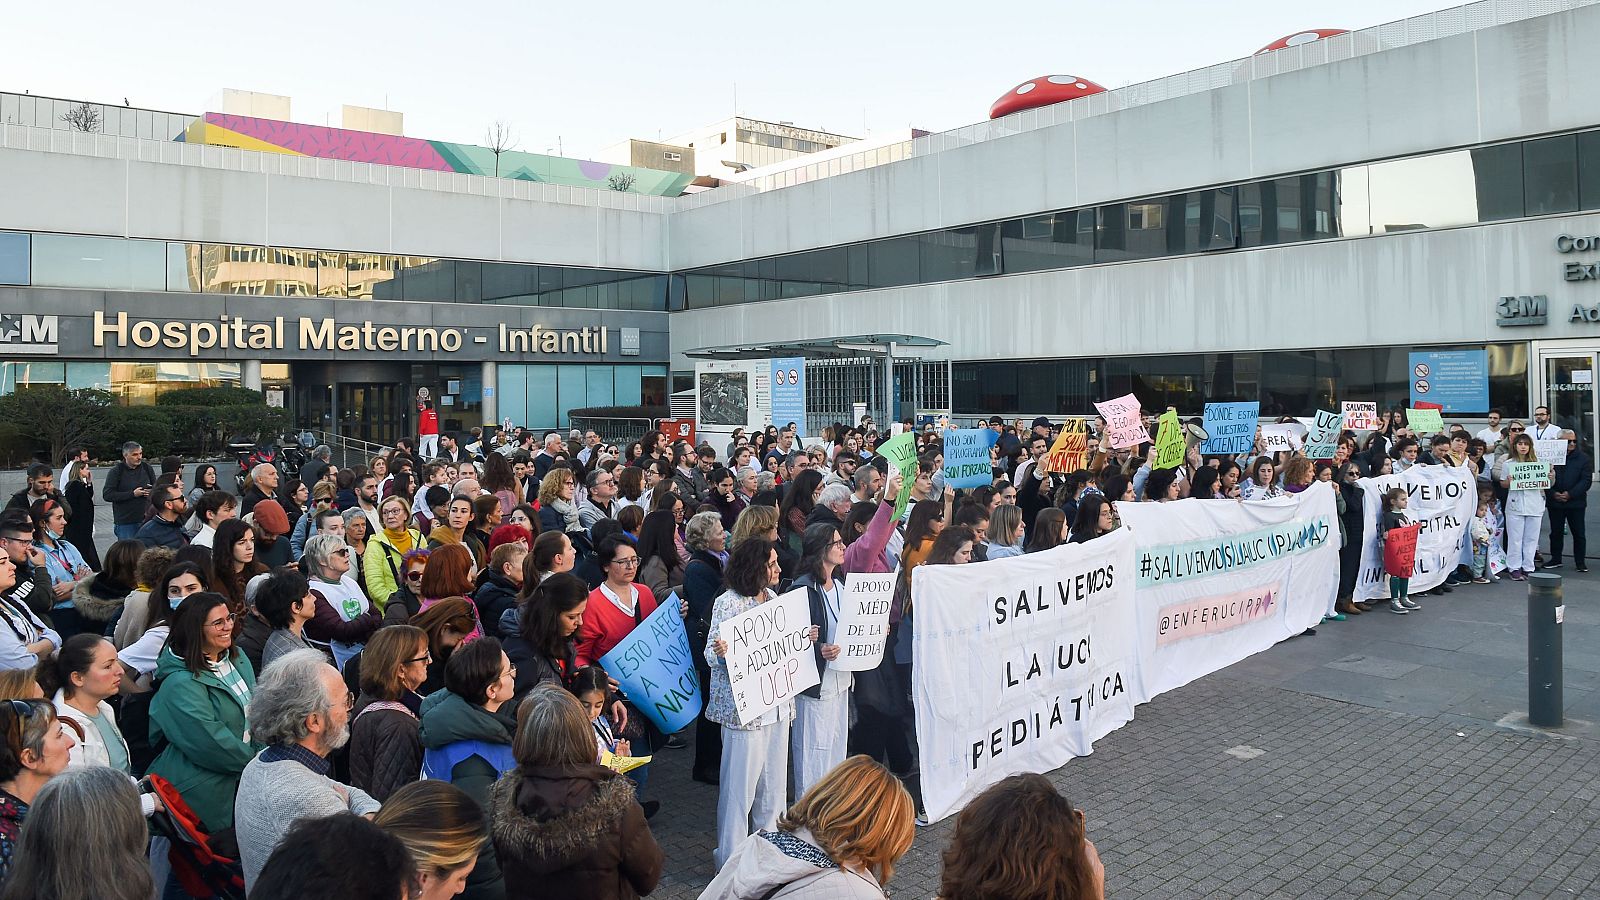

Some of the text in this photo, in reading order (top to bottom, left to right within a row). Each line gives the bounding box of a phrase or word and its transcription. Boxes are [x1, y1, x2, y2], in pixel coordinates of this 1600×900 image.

[93, 311, 284, 356] Hospital
[299, 317, 462, 352] Materno
[499, 323, 608, 354] Infantil
[1346, 402, 1375, 411] SALVEMOS
[1217, 423, 1249, 435] NUESTROS
[1348, 418, 1371, 429] UCIP
[946, 434, 976, 447] NO SON
[1517, 481, 1549, 489] NECESITAN
[852, 580, 891, 593] APOYO
[994, 565, 1114, 625] SALVEMOS
[857, 598, 889, 615] MÉD
[733, 605, 786, 655] APOYO
[848, 624, 881, 636] DE LA
[614, 600, 681, 679] ESTO AFECT
[747, 626, 812, 675] ADJUNTOS
[847, 641, 884, 657] PEDIÁ
[1006, 653, 1042, 688] LA
[640, 675, 659, 698] A
